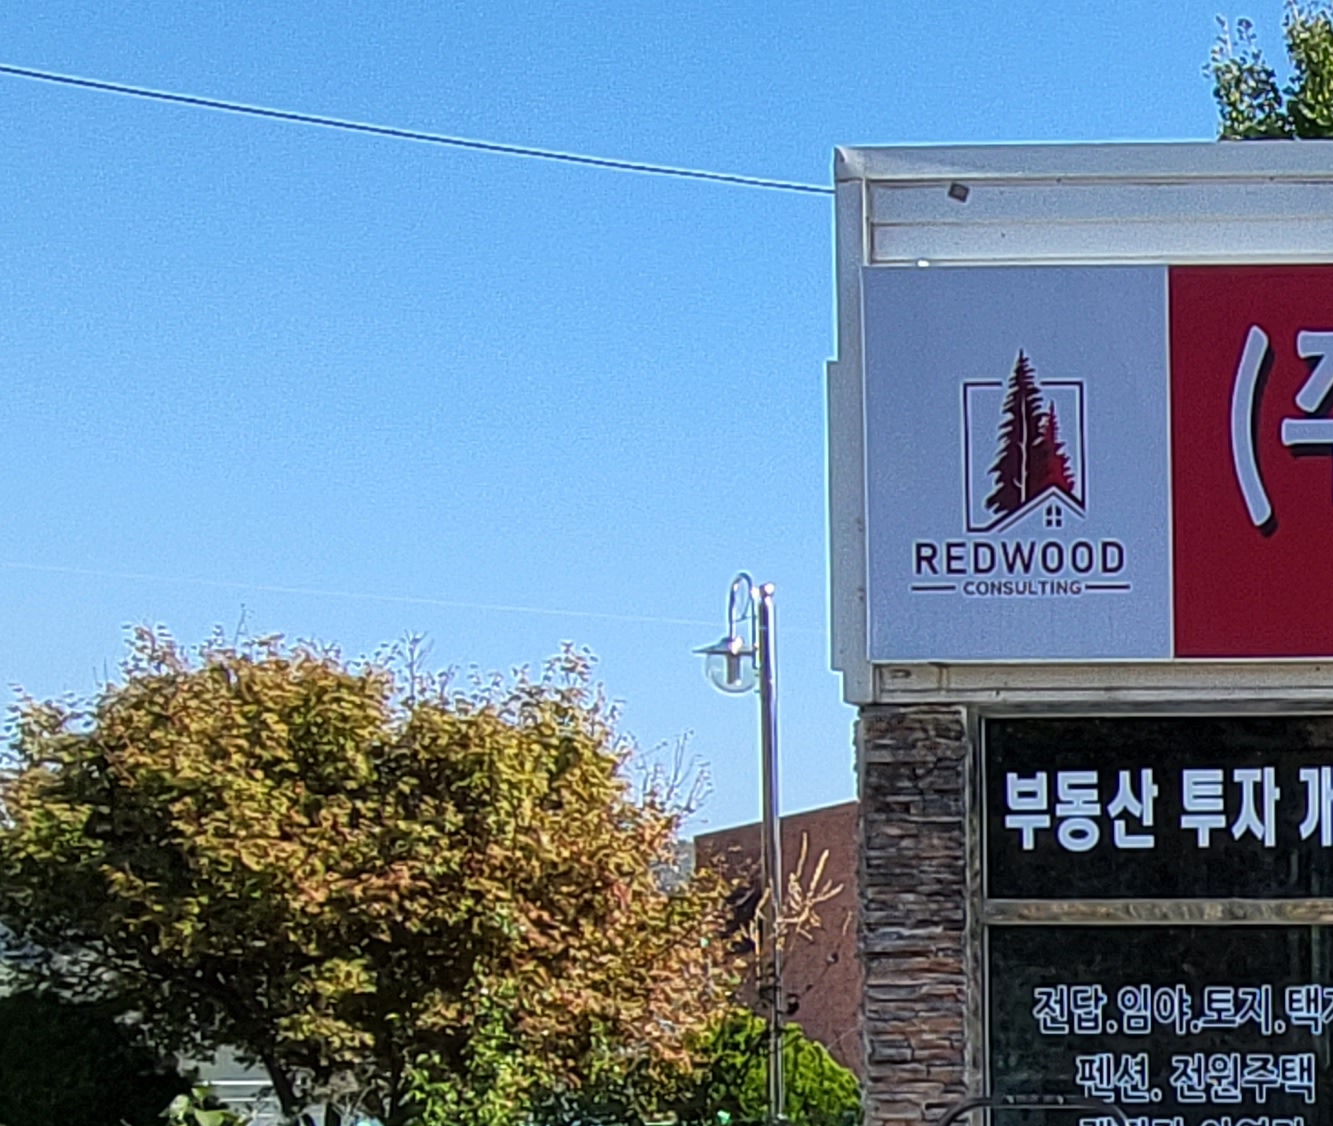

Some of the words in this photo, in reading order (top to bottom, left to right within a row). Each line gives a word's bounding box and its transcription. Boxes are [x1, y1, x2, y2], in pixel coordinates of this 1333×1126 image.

[914, 541, 1126, 574] REDWOOD
[963, 579, 1083, 597] CONSULTING
[1004, 767, 1158, 851] 부동산
[1180, 766, 1280, 849] 투자
[1170, 1053, 1317, 1104] 전원주택
